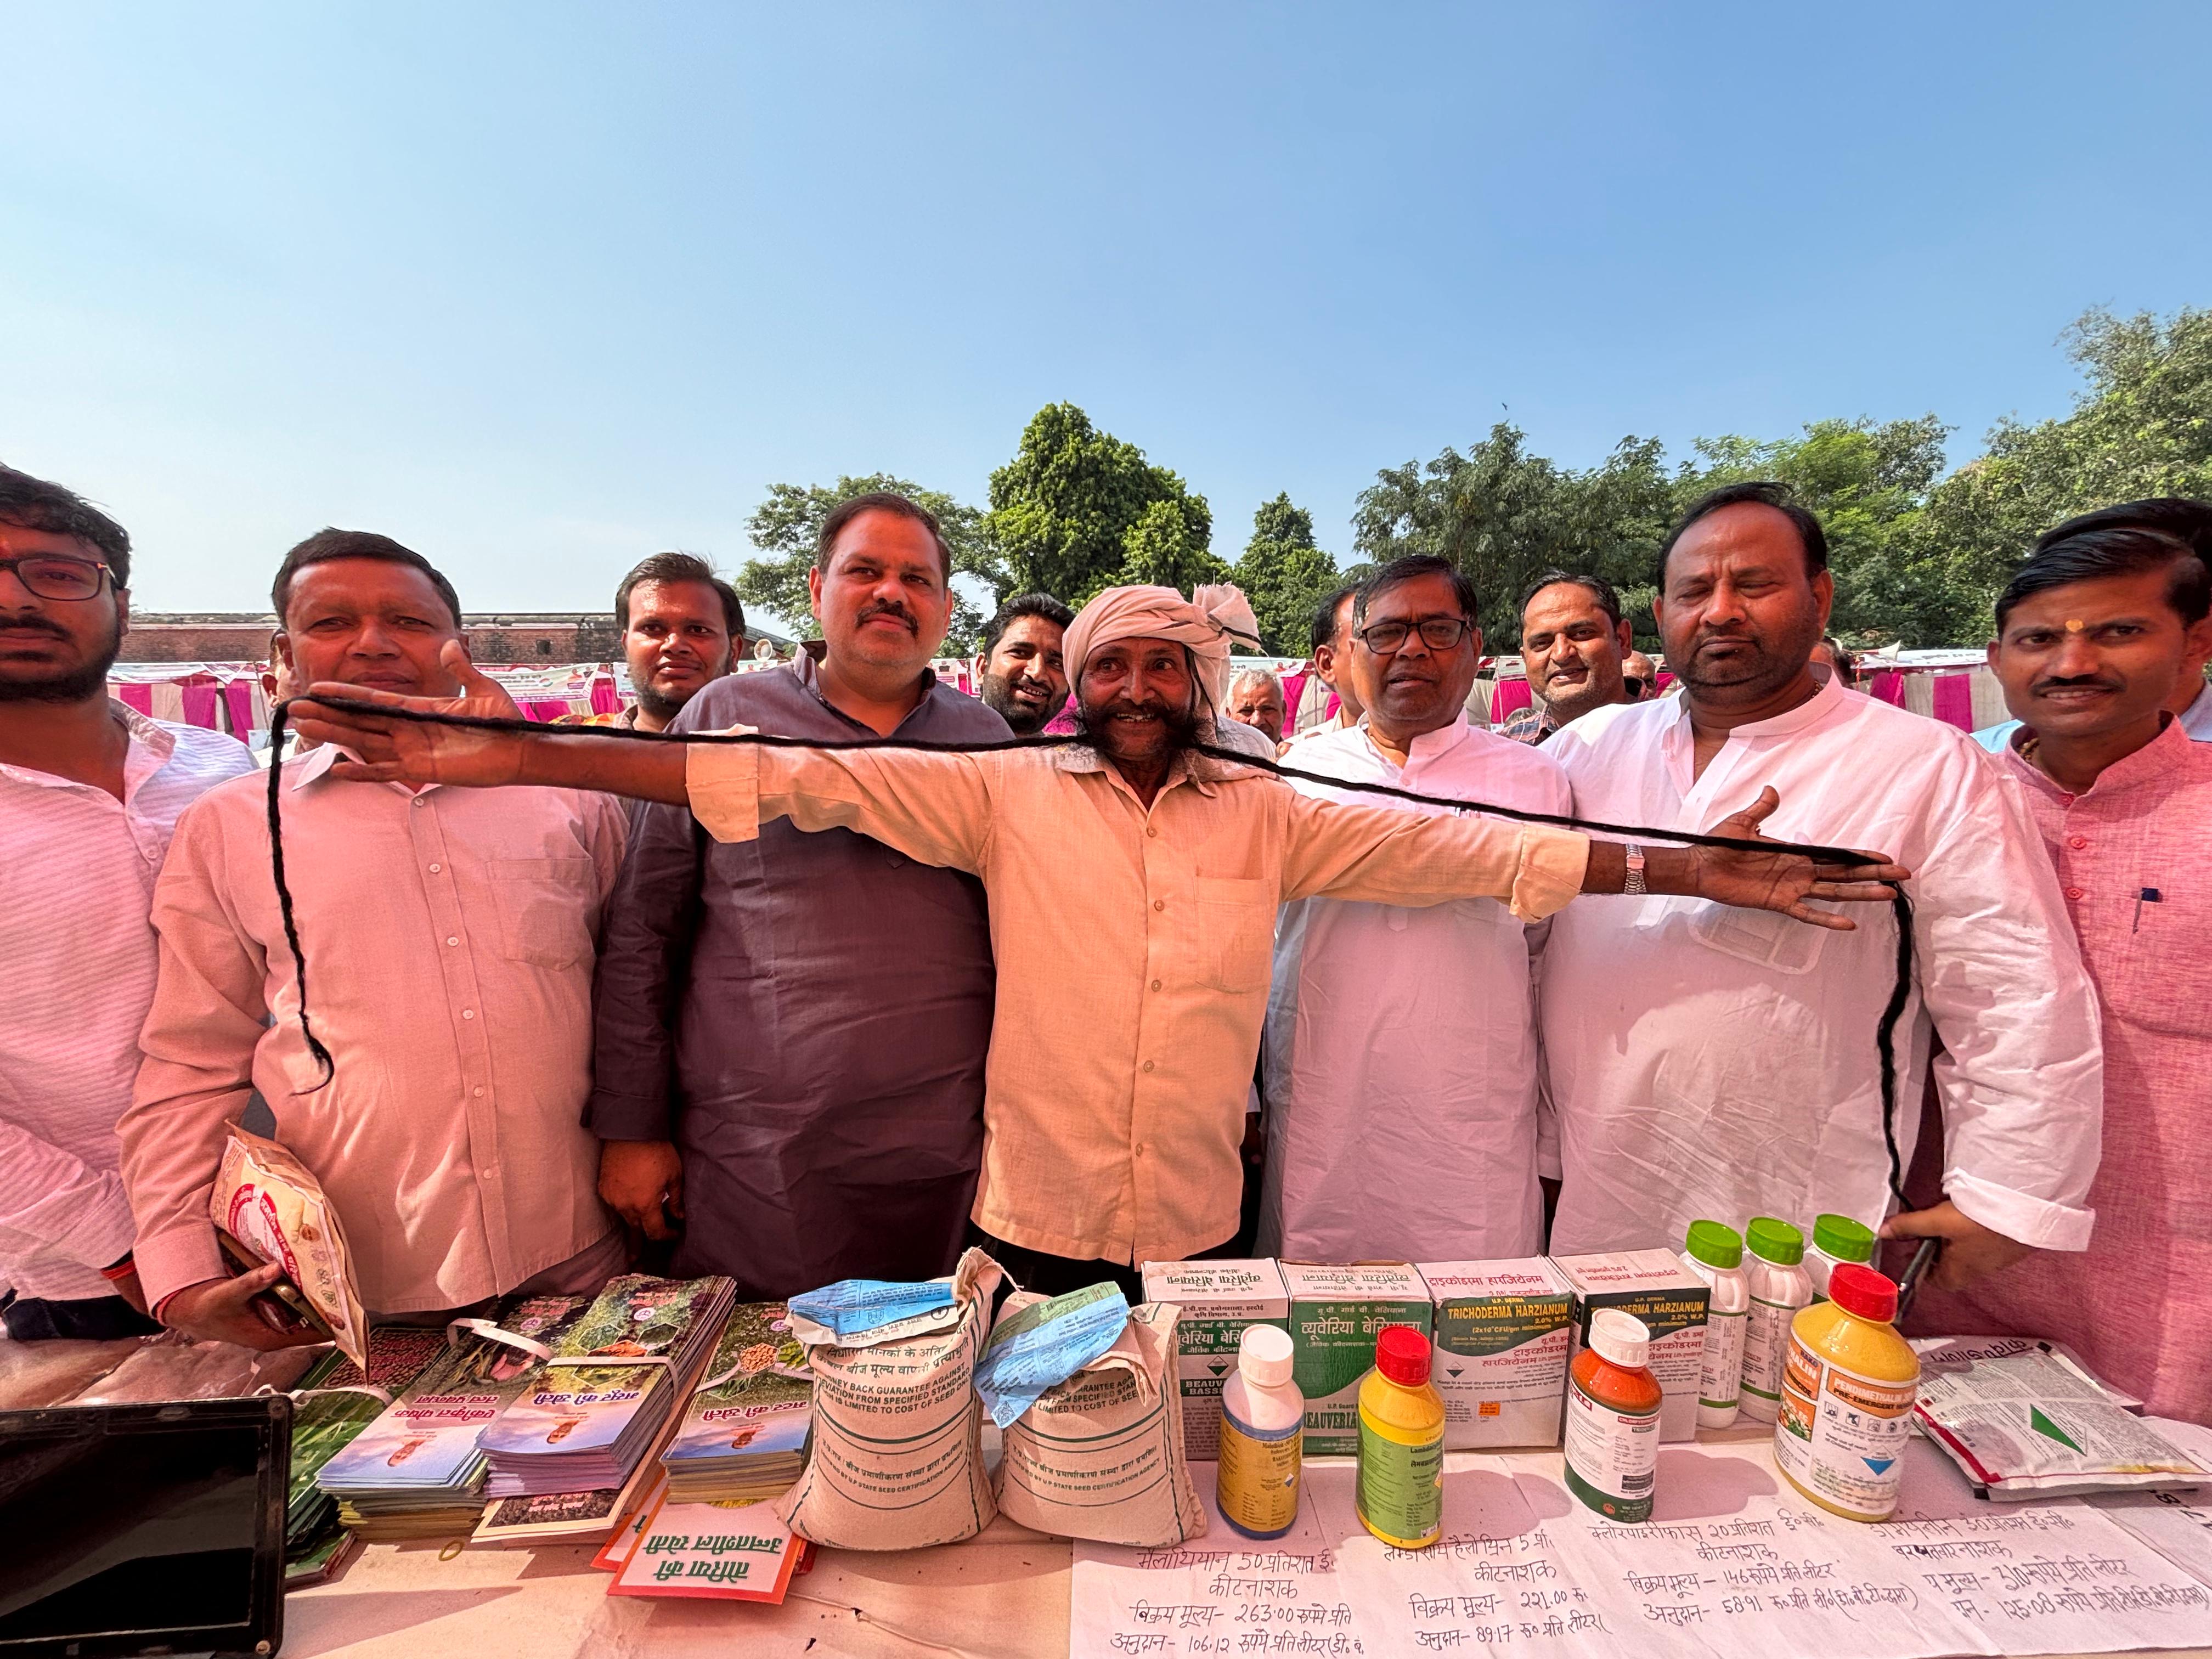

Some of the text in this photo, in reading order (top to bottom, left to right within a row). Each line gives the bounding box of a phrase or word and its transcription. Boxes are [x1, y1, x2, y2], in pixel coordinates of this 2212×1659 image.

[1426, 1276, 1483, 1286] ट्राइकोडरमा
[1448, 1303, 1568, 1319] TRICHODERMA HARZIANUM
[1653, 1301, 1704, 1313] HARZIANUM
[1301, 1316, 1356, 1341] व्यूवेरिया
[905, 1347, 916, 1357] के
[847, 1363, 868, 1374] बीज
[871, 1364, 895, 1378] मूल्य
[850, 1384, 874, 1394] BACK
[877, 1383, 931, 1395] GUARANTEE
[932, 1362, 965, 1386] AGAINST
[856, 1394, 881, 1404] FROM
[883, 1391, 929, 1405] SPECIFIED
[931, 1367, 970, 1396] STANDARD
[1073, 1382, 1136, 1403] SPECIFIED STAN
[1078, 1383, 1115, 1392] ARANTEE
[534, 1390, 639, 1405] मसूर की खेती
[836, 1395, 843, 1404] IS
[844, 1400, 878, 1413] LIMITED
[894, 1403, 918, 1414] COST
[921, 1400, 931, 1409] OF
[933, 1388, 955, 1405] SEED
[1039, 1404, 1069, 1414] LIMITED
[1084, 1400, 1106, 1411] COST
[1109, 1398, 1120, 1407] OF
[1122, 1390, 1138, 1402] SEE
[1833, 1387, 1894, 1409] PRE-EMERGENT
[390, 1406, 495, 1421] एकीकृत पोषक
[702, 1401, 807, 1421] मटर की खेती
[859, 1482, 877, 1492] STATE
[897, 1471, 944, 1492] CERTIFICATION
[1053, 1482, 1072, 1490] STATE
[1092, 1472, 1139, 1491] CERTIFICATION
[1139, 1457, 1160, 1476] AGENCY
[642, 1536, 783, 1556] उन्नतशील खेती
[1696, 1541, 1778, 1561] कीटनाशक
[653, 1560, 749, 1583] तोरिया की
[1238, 1553, 1262, 1570] 50
[1262, 1550, 1315, 1575] प्रतिशत
[1474, 1560, 1556, 1583] कीटनाशक
[1209, 1573, 1297, 1599] कीटनाशक
[1723, 1568, 1749, 1584] 146
